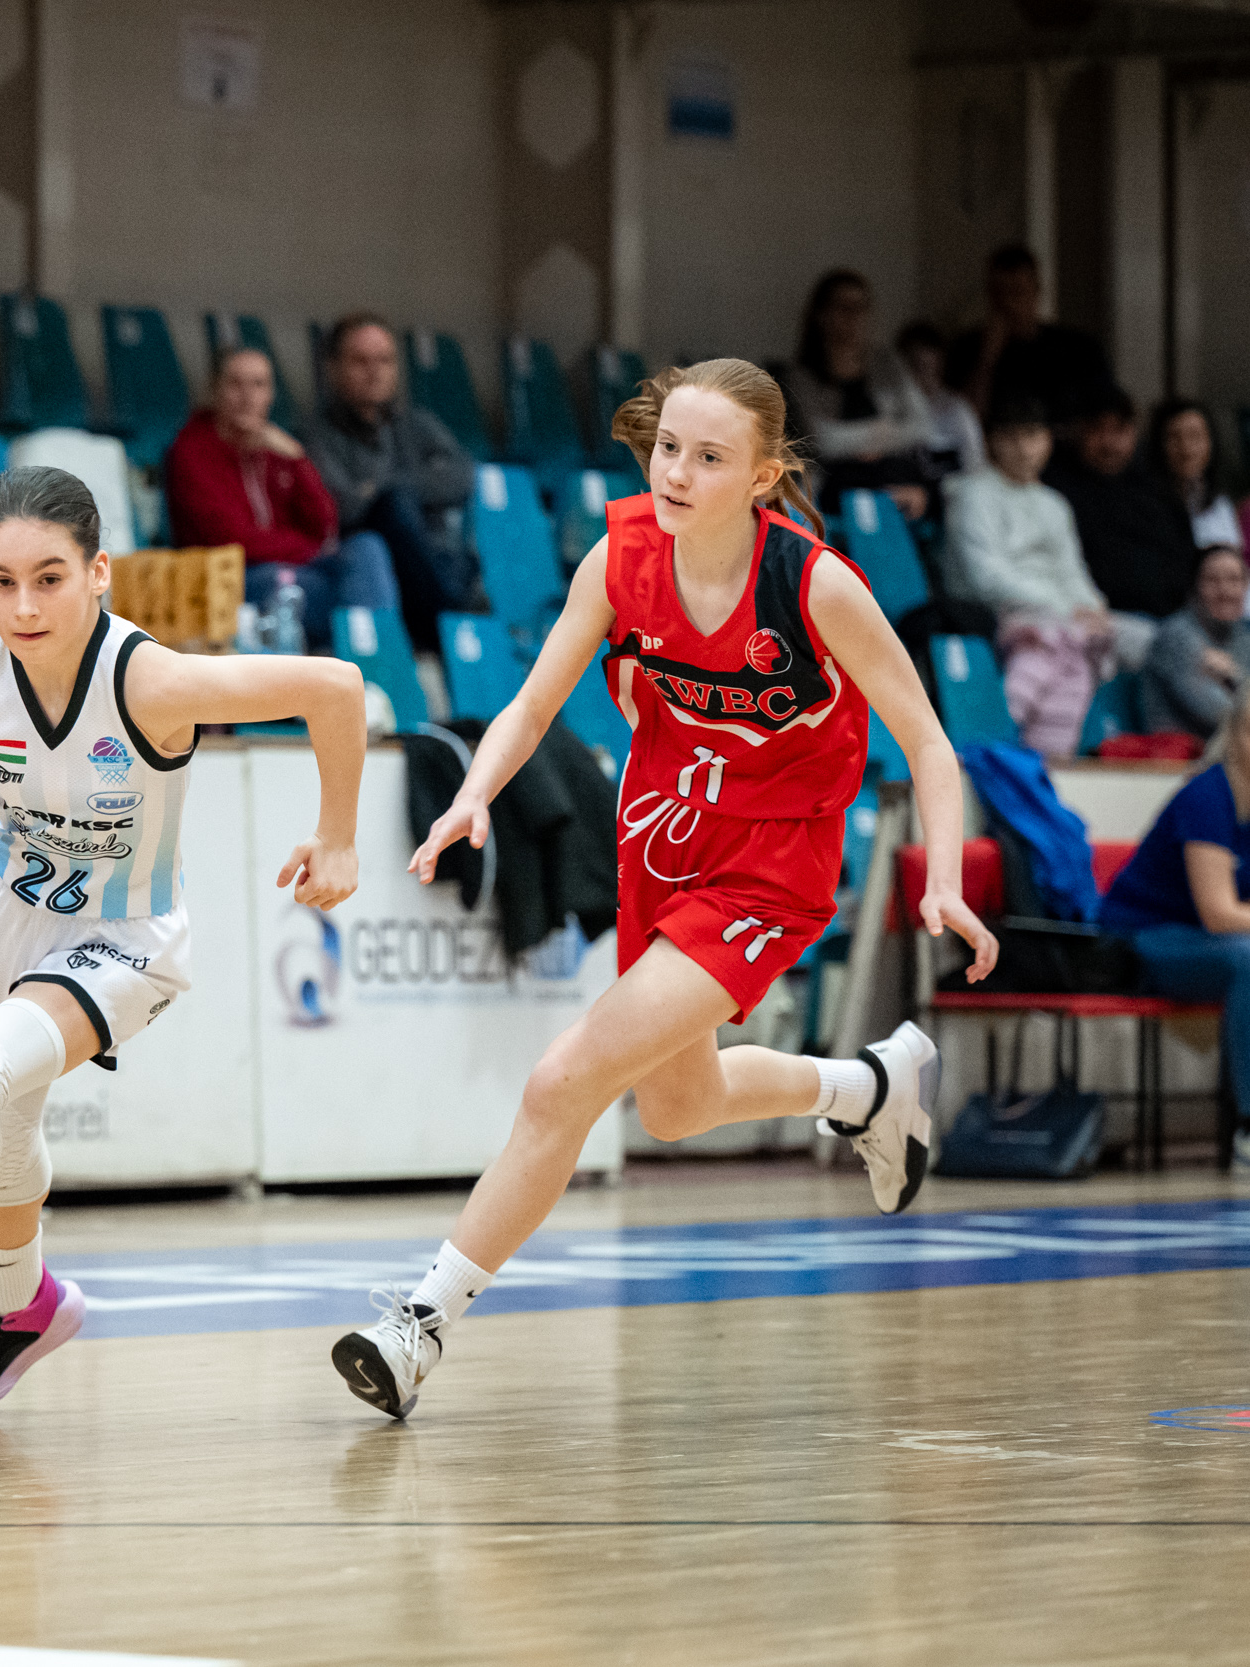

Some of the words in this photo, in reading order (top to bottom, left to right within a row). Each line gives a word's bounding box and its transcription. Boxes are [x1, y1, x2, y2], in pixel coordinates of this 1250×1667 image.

[676, 745, 731, 805] 11
[71, 817, 134, 831] KSC
[10, 851, 89, 914] 26
[721, 916, 785, 965] 11
